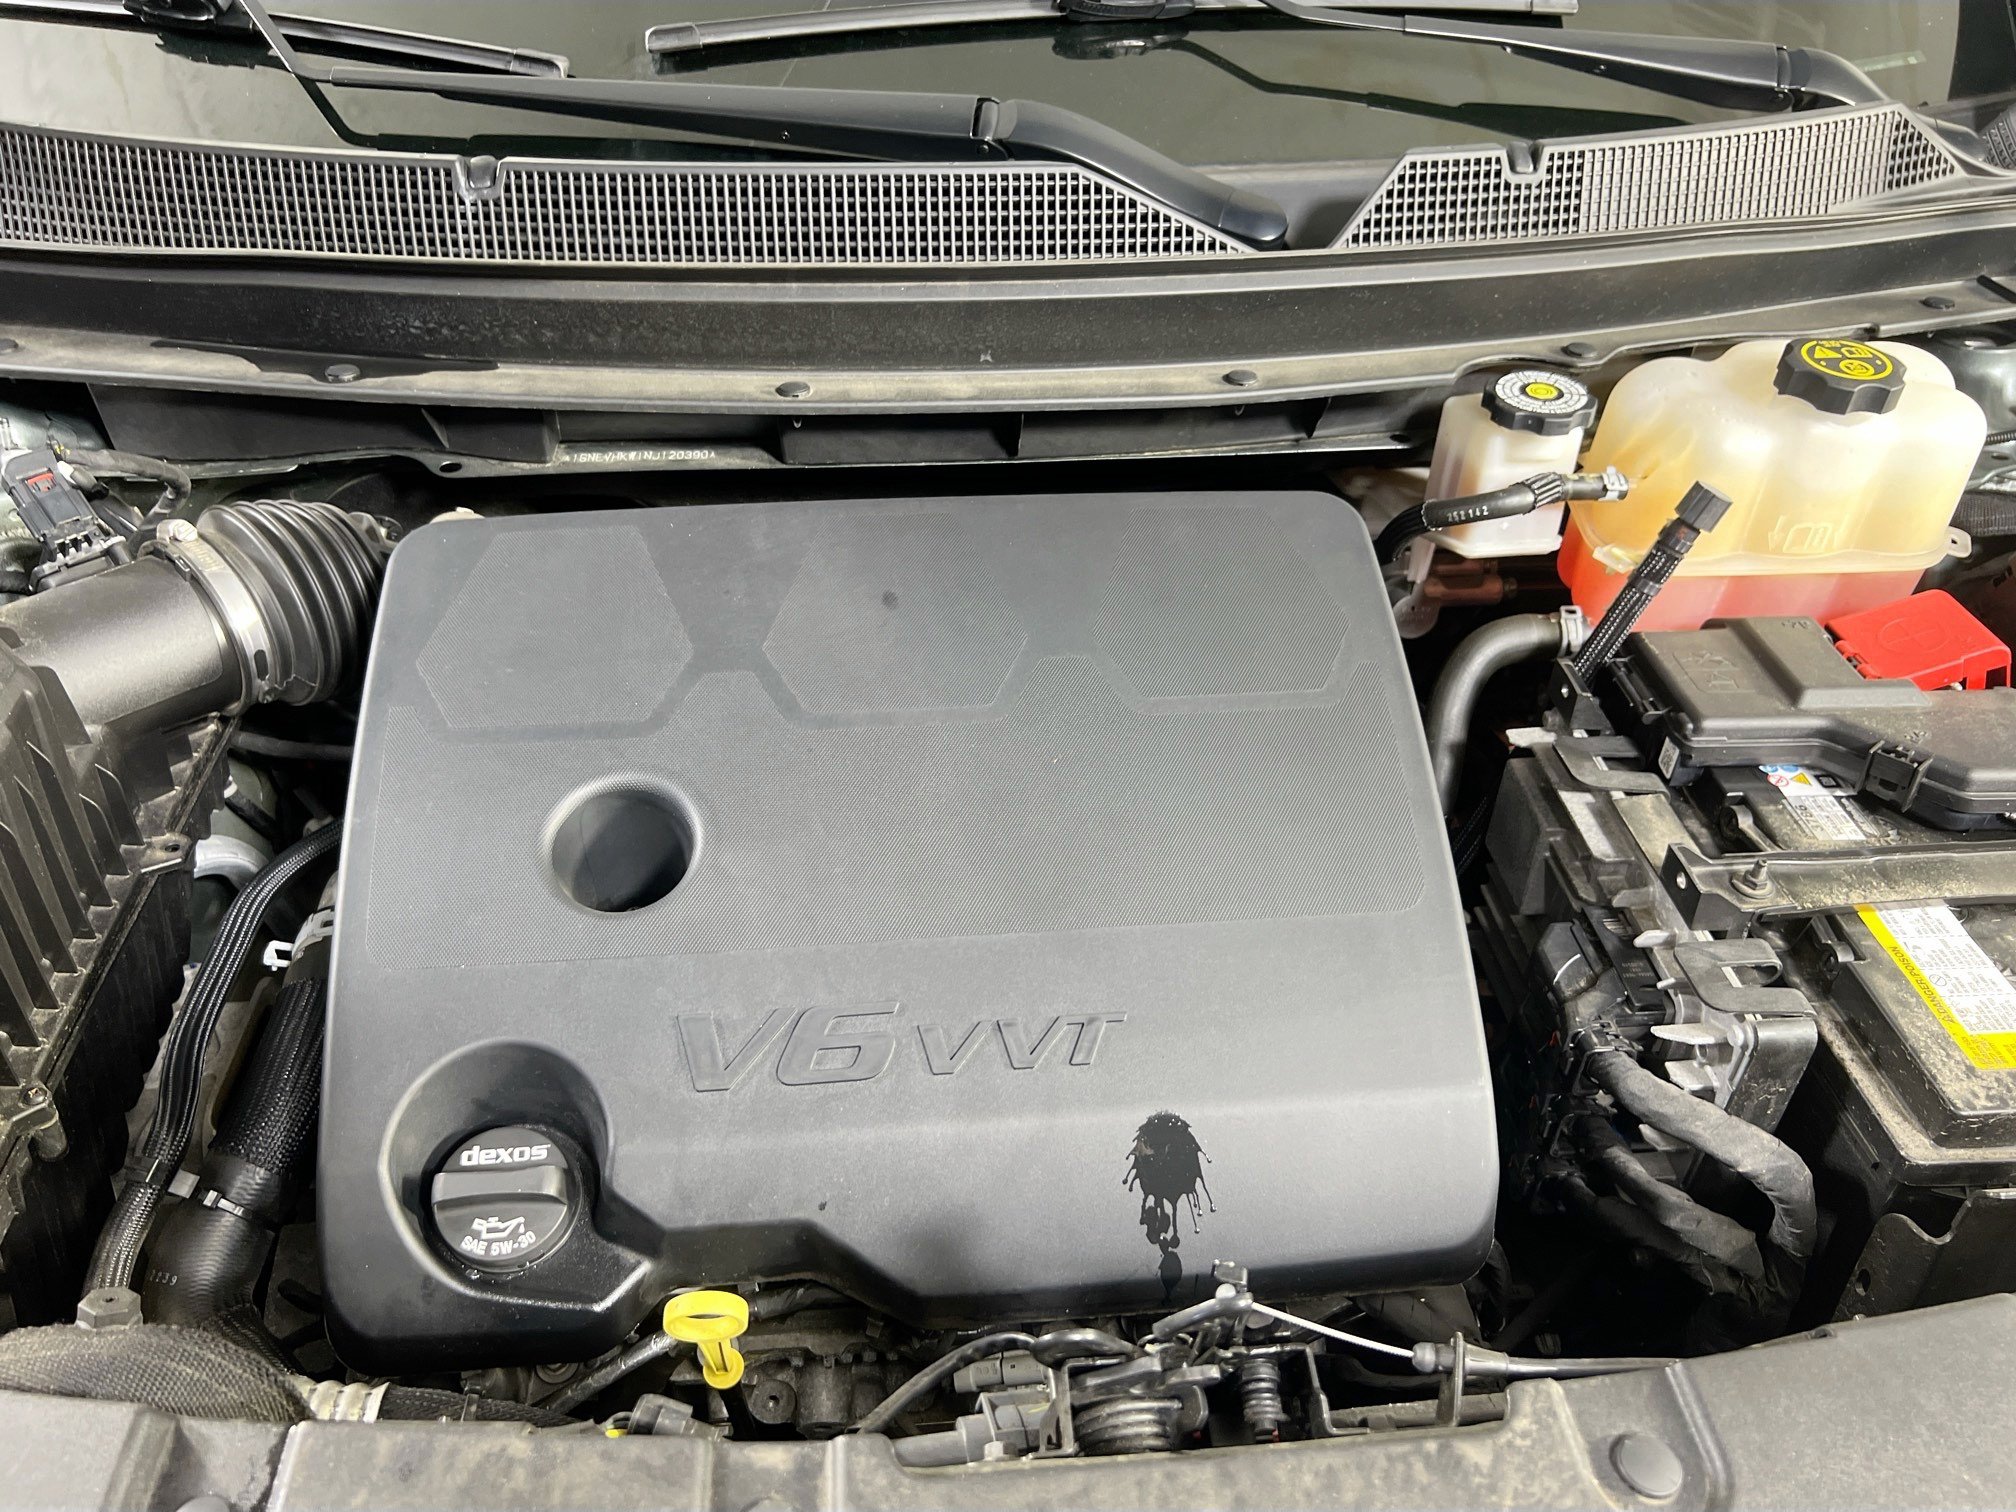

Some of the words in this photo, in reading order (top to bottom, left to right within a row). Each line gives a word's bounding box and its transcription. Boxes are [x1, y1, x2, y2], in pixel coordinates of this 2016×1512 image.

[676, 1002, 899, 1092] V6
[917, 1011, 1127, 1075] VVT
[461, 1145, 551, 1167] dexos
[461, 1235, 488, 1256] SAE
[490, 1231, 536, 1256] 5W-30
